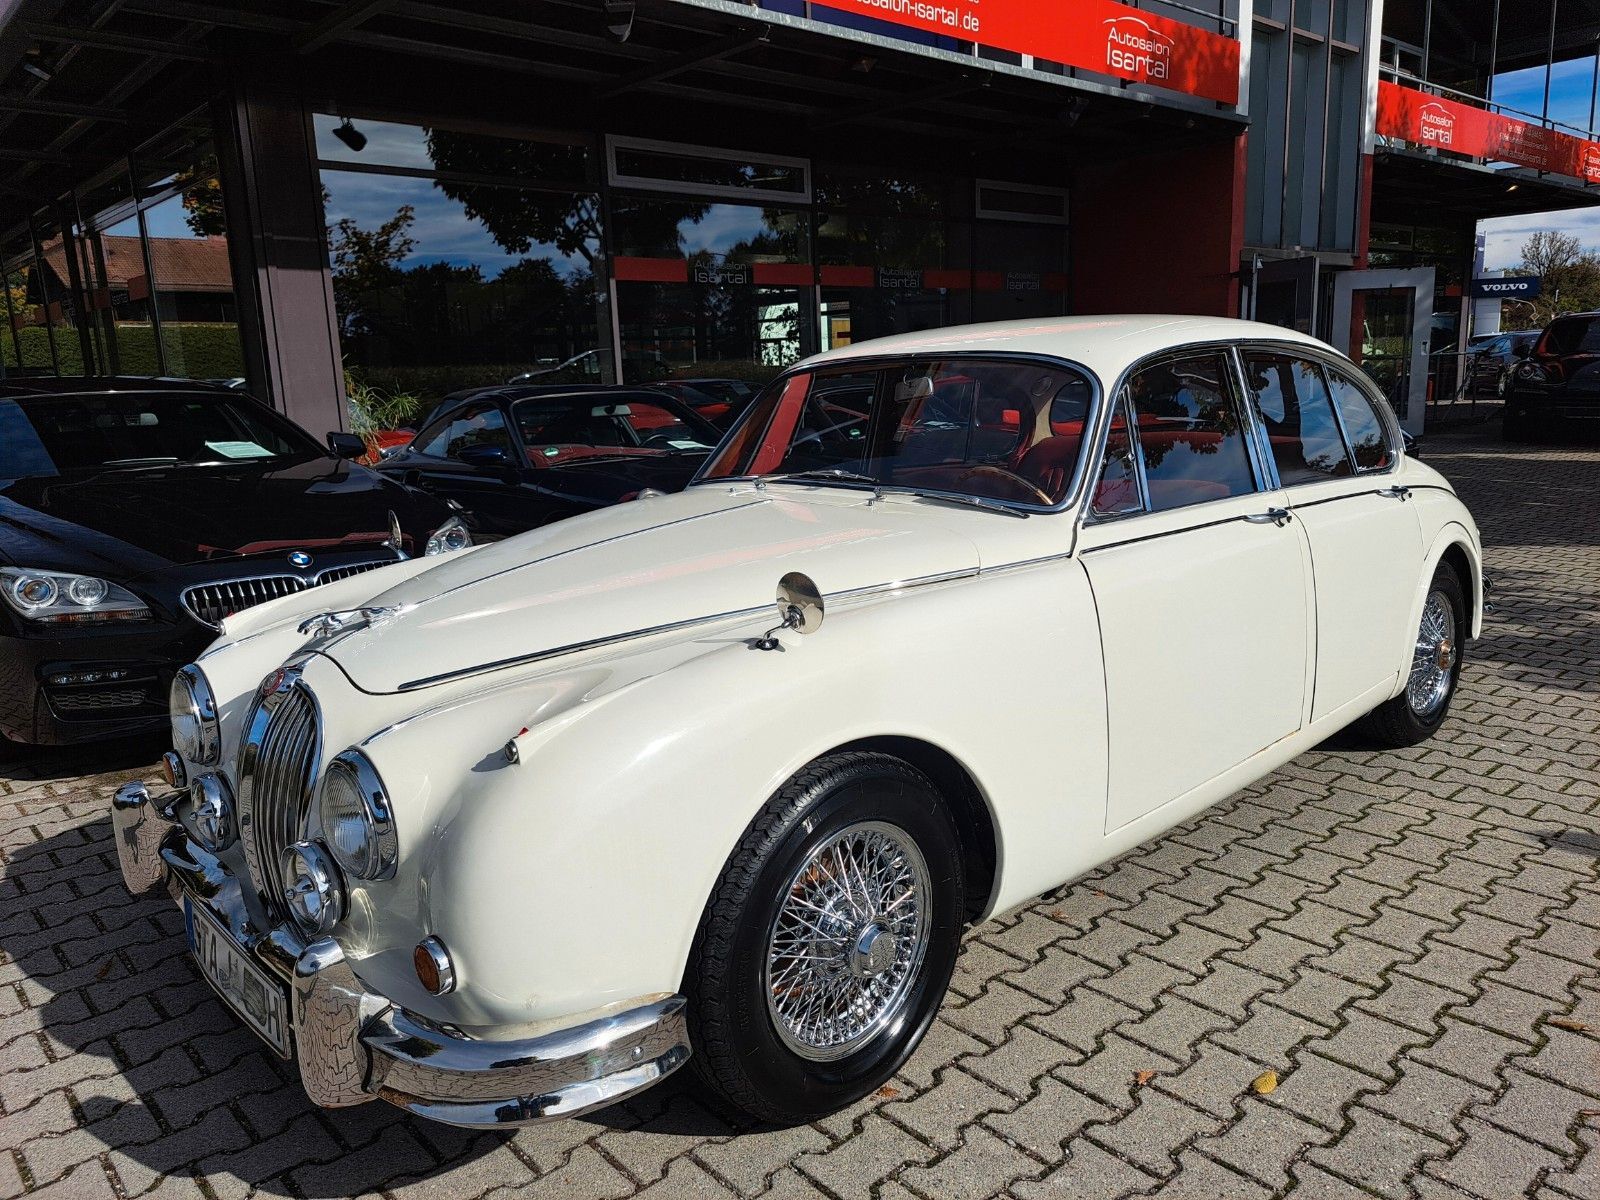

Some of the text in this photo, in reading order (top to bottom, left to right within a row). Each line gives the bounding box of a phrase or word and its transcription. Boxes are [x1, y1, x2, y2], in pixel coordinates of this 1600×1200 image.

[1108, 26, 1170, 57] Autosalon
[1106, 41, 1169, 79] Isartal
[1421, 111, 1453, 128] Autosalon
[1420, 121, 1453, 144] Isartal
[694, 268, 747, 284] Isartal
[879, 275, 920, 288] Isartal
[1481, 283, 1528, 292] VOLVO
